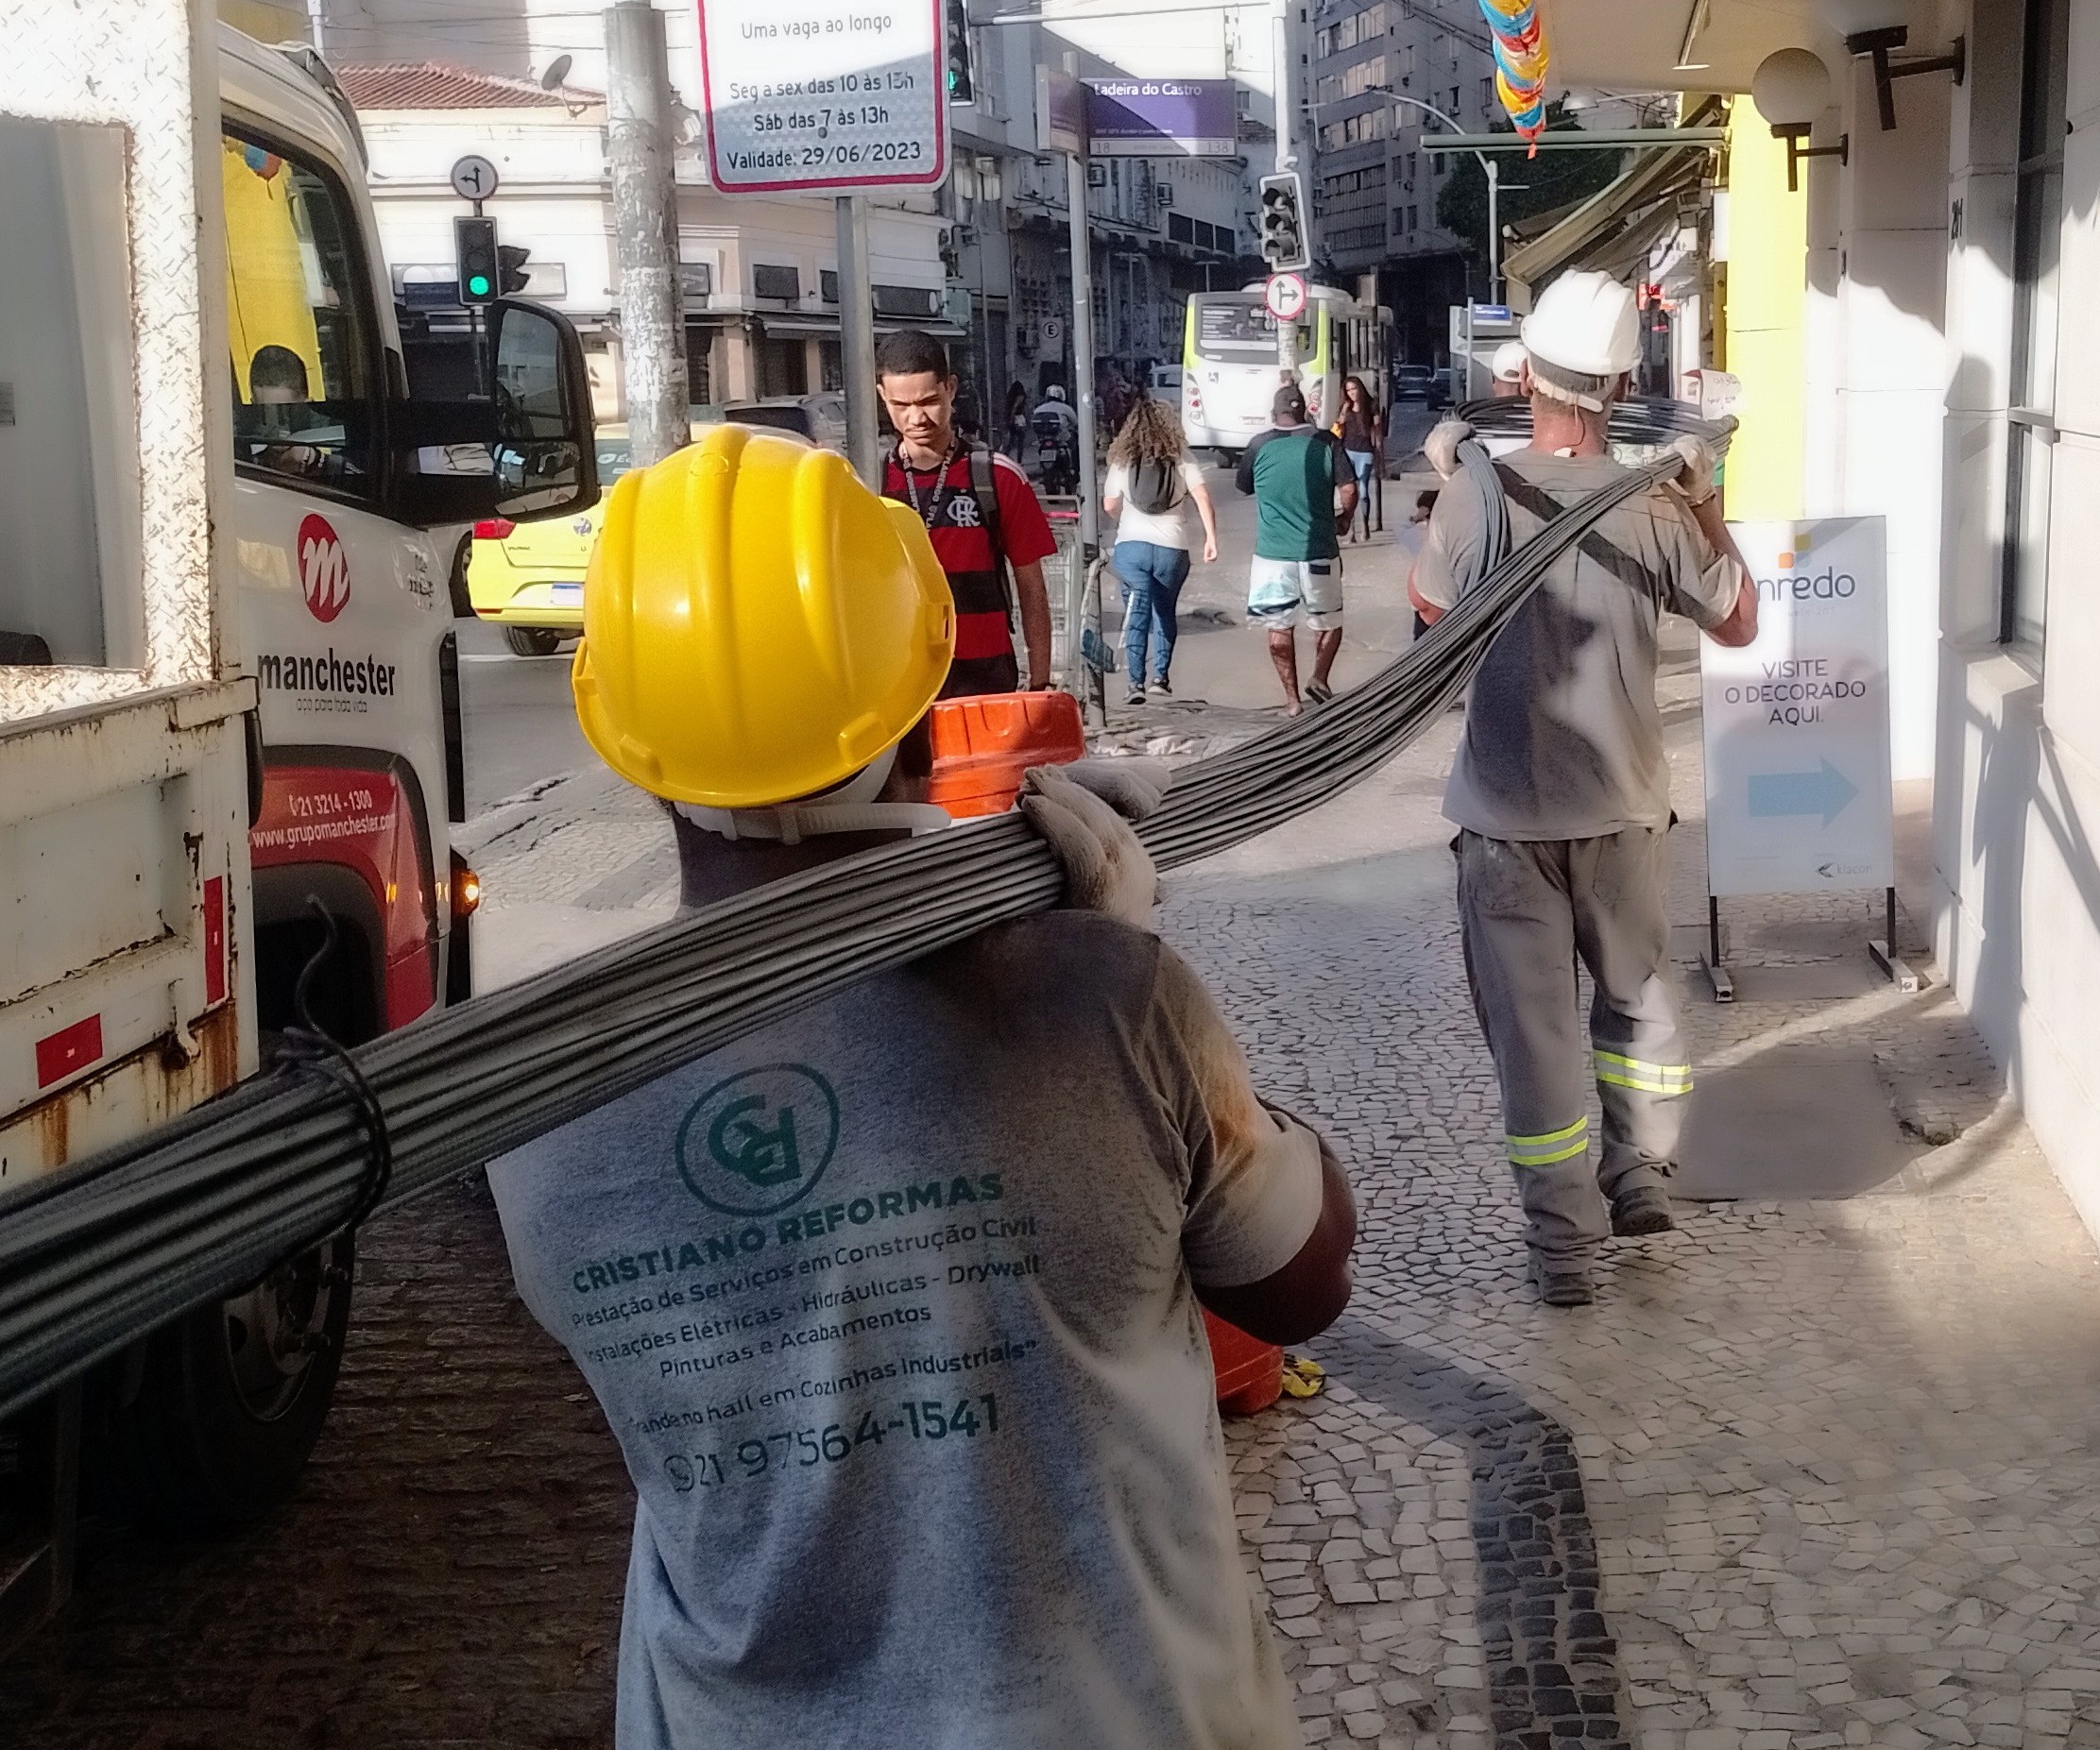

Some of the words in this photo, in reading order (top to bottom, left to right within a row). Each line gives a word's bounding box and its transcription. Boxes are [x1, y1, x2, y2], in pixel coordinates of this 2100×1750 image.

[741, 22, 777, 40] Uma
[782, 20, 820, 39] vaga
[826, 18, 844, 33] ao
[849, 14, 892, 34] longo
[729, 82, 760, 104] Seg
[763, 84, 773, 98] a
[776, 81, 804, 96] sex
[808, 77, 835, 94] das
[839, 74, 858, 93] 10
[863, 73, 881, 91] às
[1094, 82, 1139, 96] Ladeira
[1141, 82, 1159, 95] do
[1162, 82, 1203, 96] Castro
[754, 112, 783, 132] Sáb
[788, 110, 815, 129] das
[820, 109, 831, 127] 7
[837, 109, 856, 126] às
[861, 106, 889, 125] 13h
[801, 142, 921, 166] 29/06/2023
[1757, 566, 1855, 602] nredo
[257, 647, 396, 696] manchester
[1761, 658, 1829, 680] VISITE
[1724, 687, 1741, 705] O
[1746, 681, 1867, 704] DECORADO
[298, 795, 314, 817] 21
[315, 792, 342, 815] 3214
[572, 1227, 767, 1294] CRISTIANO
[775, 1172, 1005, 1245] REFORMAS
[572, 1295, 654, 1330] Prestação
[657, 1289, 685, 1309] de
[689, 1261, 794, 1303] Serviços
[798, 1255, 832, 1276] em
[834, 1224, 976, 1266] Construção
[982, 1215, 1037, 1239] Civil
[587, 1330, 676, 1363] stalações
[680, 1305, 783, 1343] Elétricas
[802, 1274, 927, 1313] Hidráulicas
[948, 1253, 1040, 1285] Drywall
[659, 1345, 754, 1379] Pinturas
[760, 1339, 774, 1354] e
[779, 1306, 931, 1350] Acabamentos
[683, 1410, 704, 1425] no
[706, 1394, 754, 1422] hall
[759, 1387, 795, 1407] em
[800, 1362, 897, 1398] Cozinhas
[694, 1453, 725, 1487] 21
[737, 1392, 999, 1477] 97564-1541
